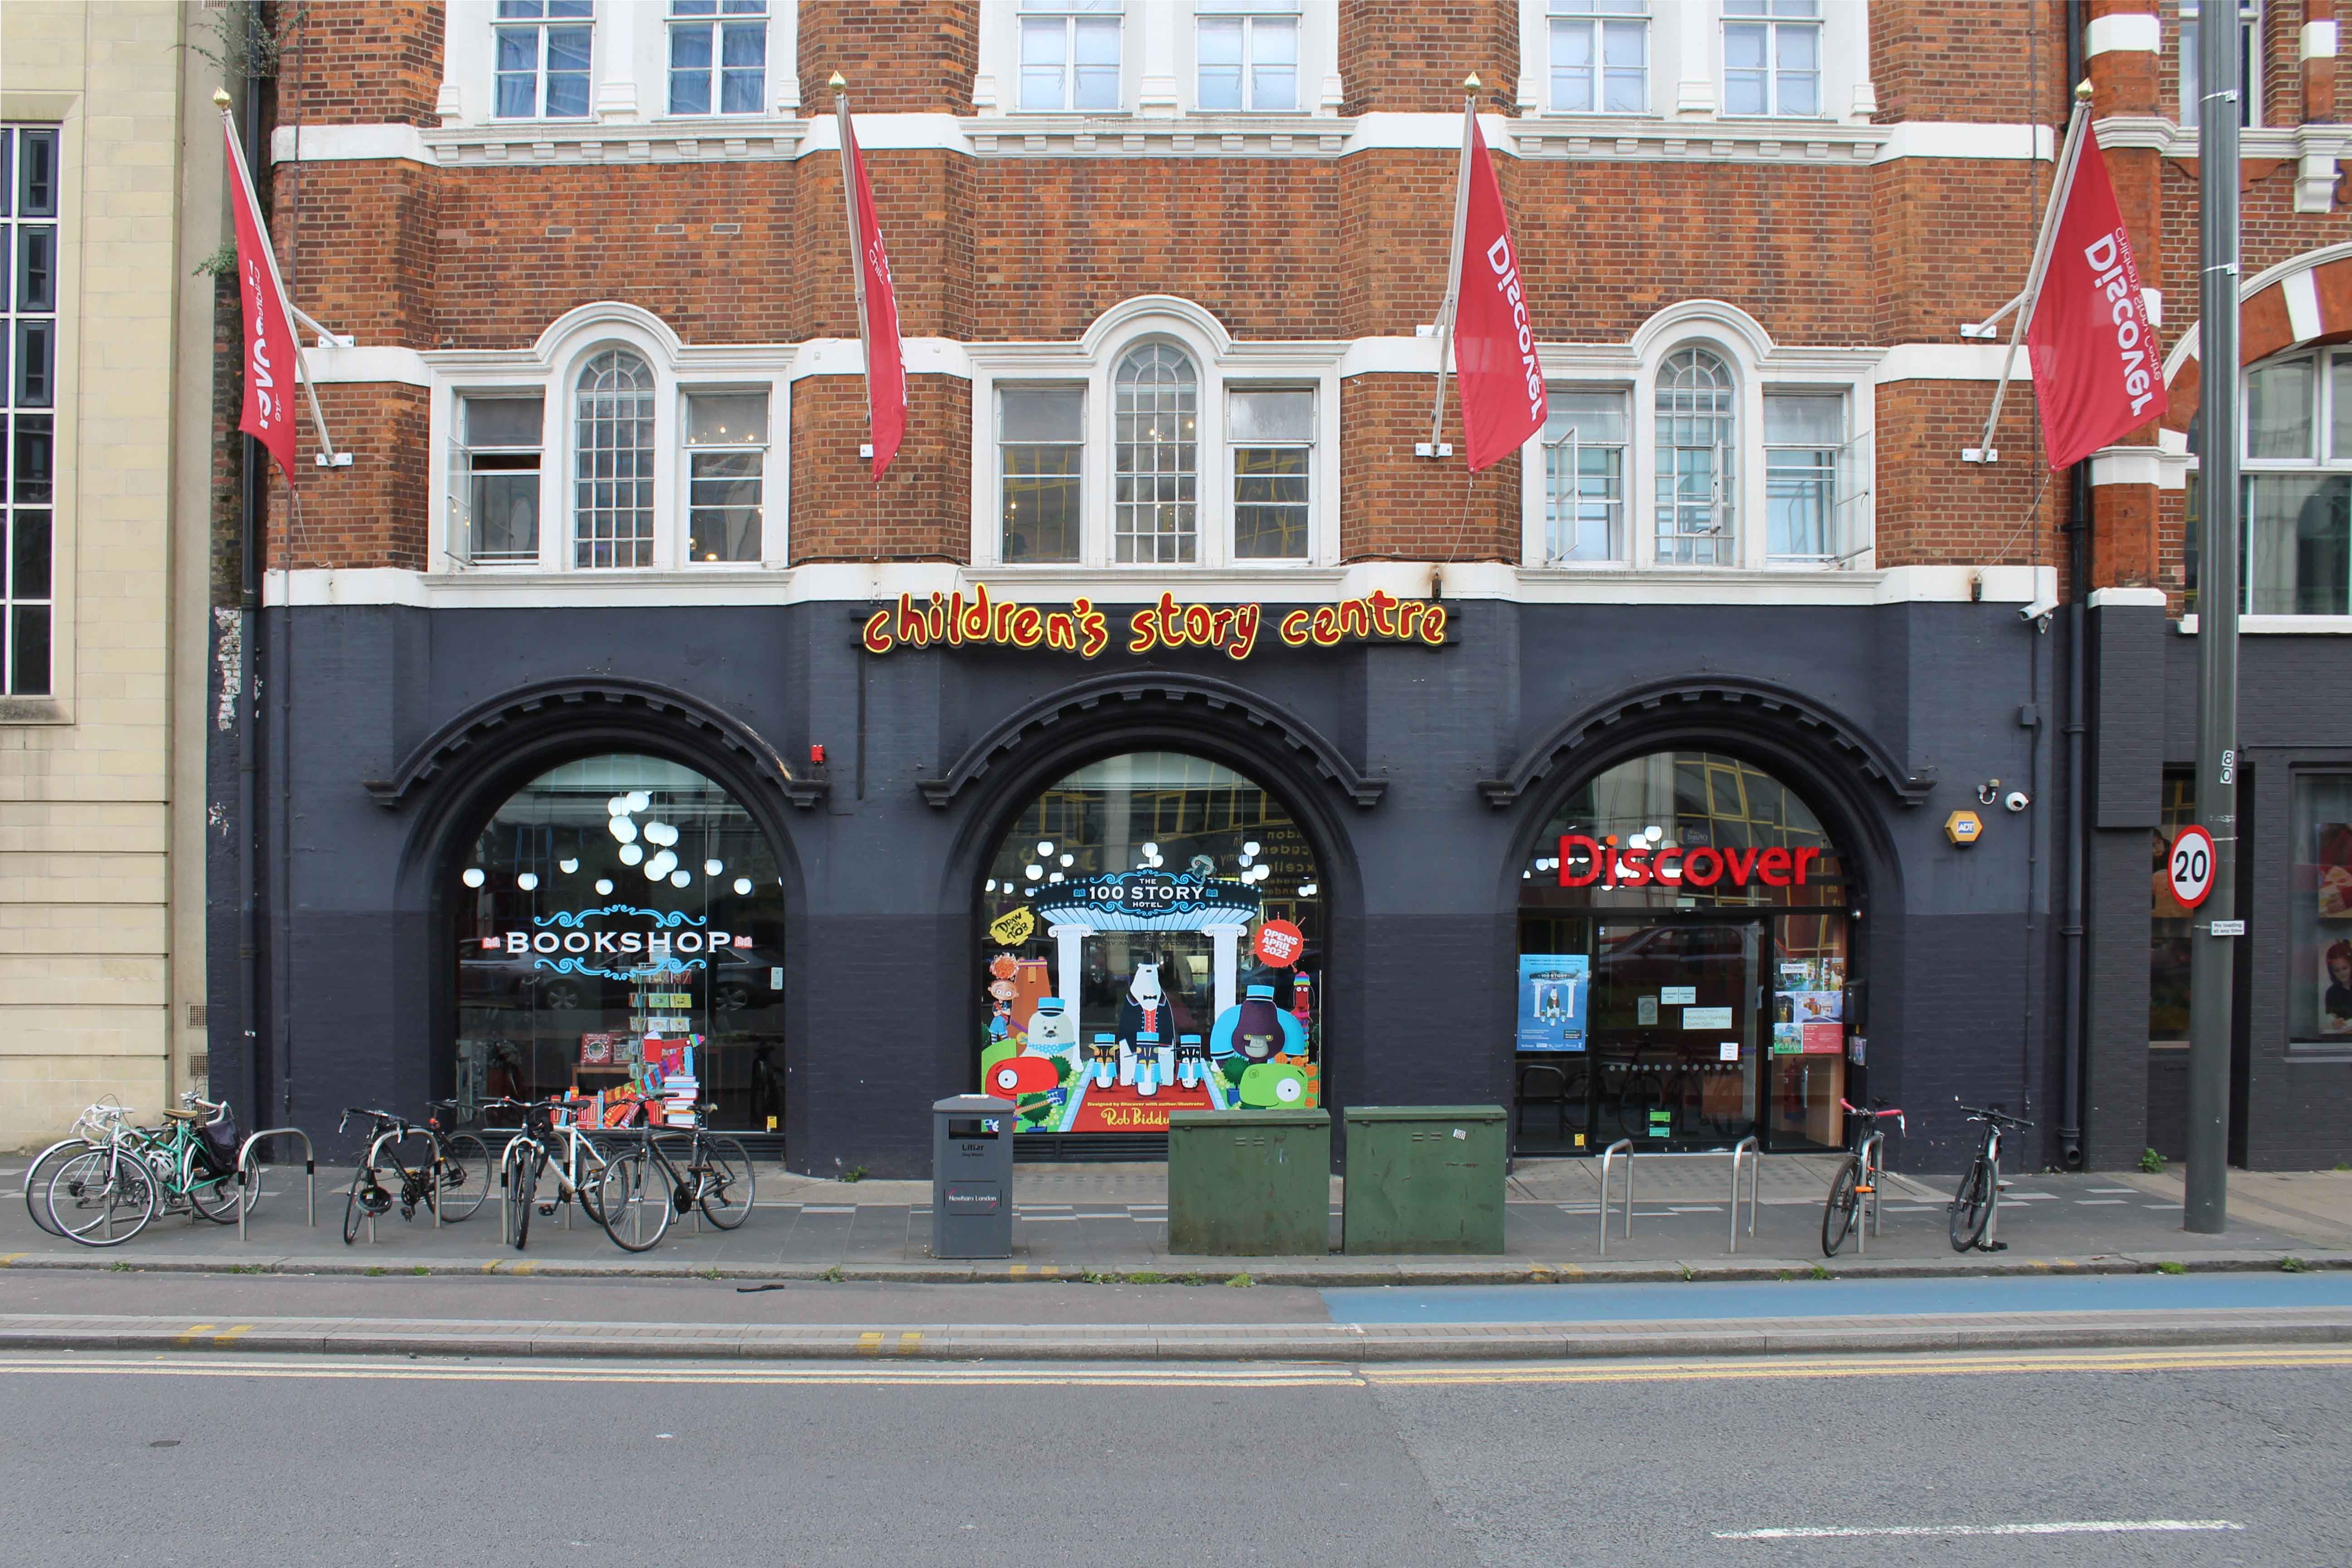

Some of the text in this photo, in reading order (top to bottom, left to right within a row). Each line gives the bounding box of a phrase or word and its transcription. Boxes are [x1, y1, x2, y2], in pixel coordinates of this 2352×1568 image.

[863, 582, 1446, 660] children's story centre
[1958, 822, 1975, 831] ADT
[1558, 834, 1820, 887] Discover
[2174, 850, 2208, 883] 20
[1089, 886, 1205, 900] 100 STORY
[995, 912, 1022, 933] DRAW
[505, 931, 731, 953] BOOKSHOP
[1262, 936, 1292, 952] APRIL
[1264, 928, 1298, 946] OPENS
[1263, 945, 1289, 959] 2022
[1100, 1107, 1130, 1126] Rob
